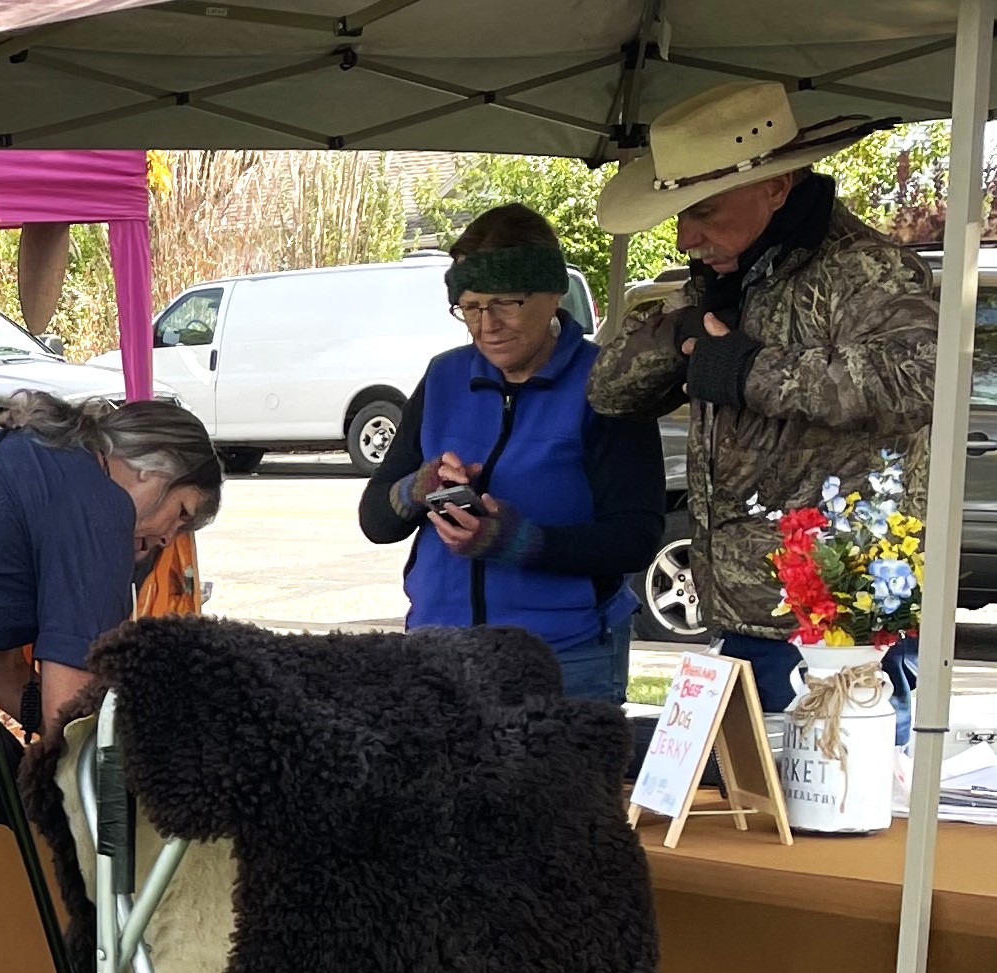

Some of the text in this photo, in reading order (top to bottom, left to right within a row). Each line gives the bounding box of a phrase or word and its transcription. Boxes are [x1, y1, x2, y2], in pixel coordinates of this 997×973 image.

[680, 678, 705, 699] BEEF
[667, 702, 693, 730] DOG
[649, 729, 693, 767] JERKY
